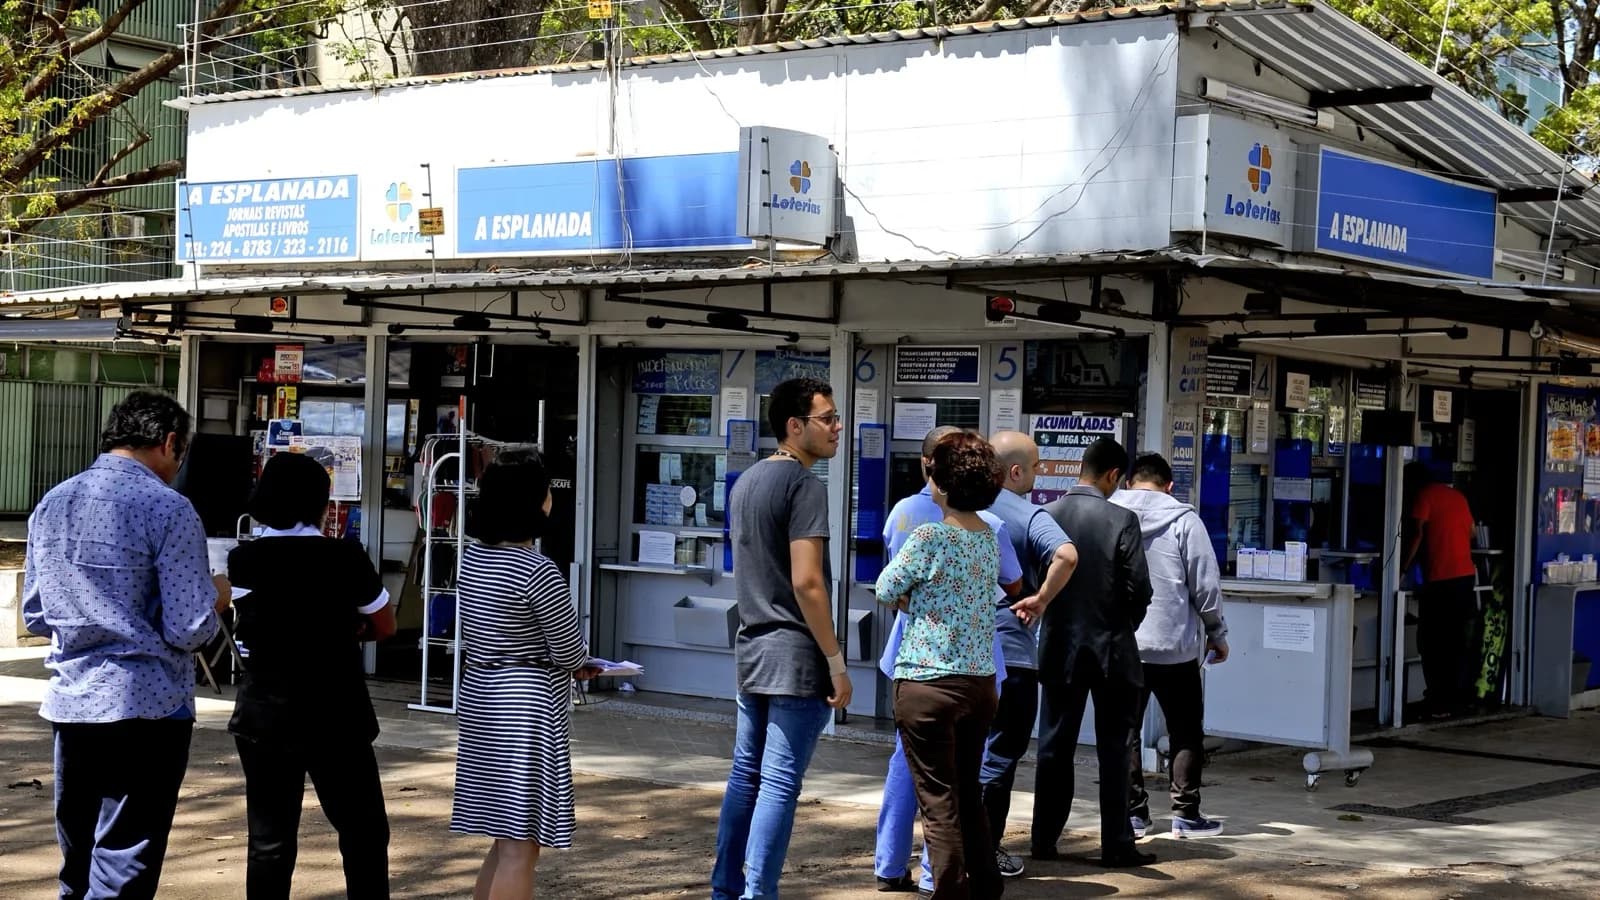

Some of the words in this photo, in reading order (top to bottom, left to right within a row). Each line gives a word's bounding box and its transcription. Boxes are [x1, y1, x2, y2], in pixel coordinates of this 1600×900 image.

[188, 187, 202, 206] A
[209, 179, 349, 204] ESPLANADA
[227, 207, 263, 221] JORNAIS
[265, 204, 305, 219] REVISTAS
[771, 193, 821, 216] Loterias
[1224, 194, 1281, 225] Loterias
[223, 222, 270, 238] APOSTILAS
[270, 222, 277, 236] E
[277, 220, 309, 235] LIVROS
[370, 226, 432, 245] Loteria
[474, 217, 487, 240] A
[492, 211, 592, 239] ESPLANADA
[1329, 212, 1339, 239] A
[1341, 215, 1408, 253] ESPLANADA
[210, 241, 231, 257] 224
[242, 240, 272, 256] 8783
[283, 238, 305, 255] 323
[317, 237, 349, 254] 2116
[855, 349, 875, 383] 6
[994, 346, 1017, 382] 5
[1257, 363, 1269, 394] 4
[1035, 416, 1116, 431] ACUMULADAS
[1174, 421, 1194, 432] CAIXA
[1056, 434, 1079, 445] MEGA
[1174, 447, 1193, 459] AQUI
[1055, 463, 1082, 474] LOTOM
